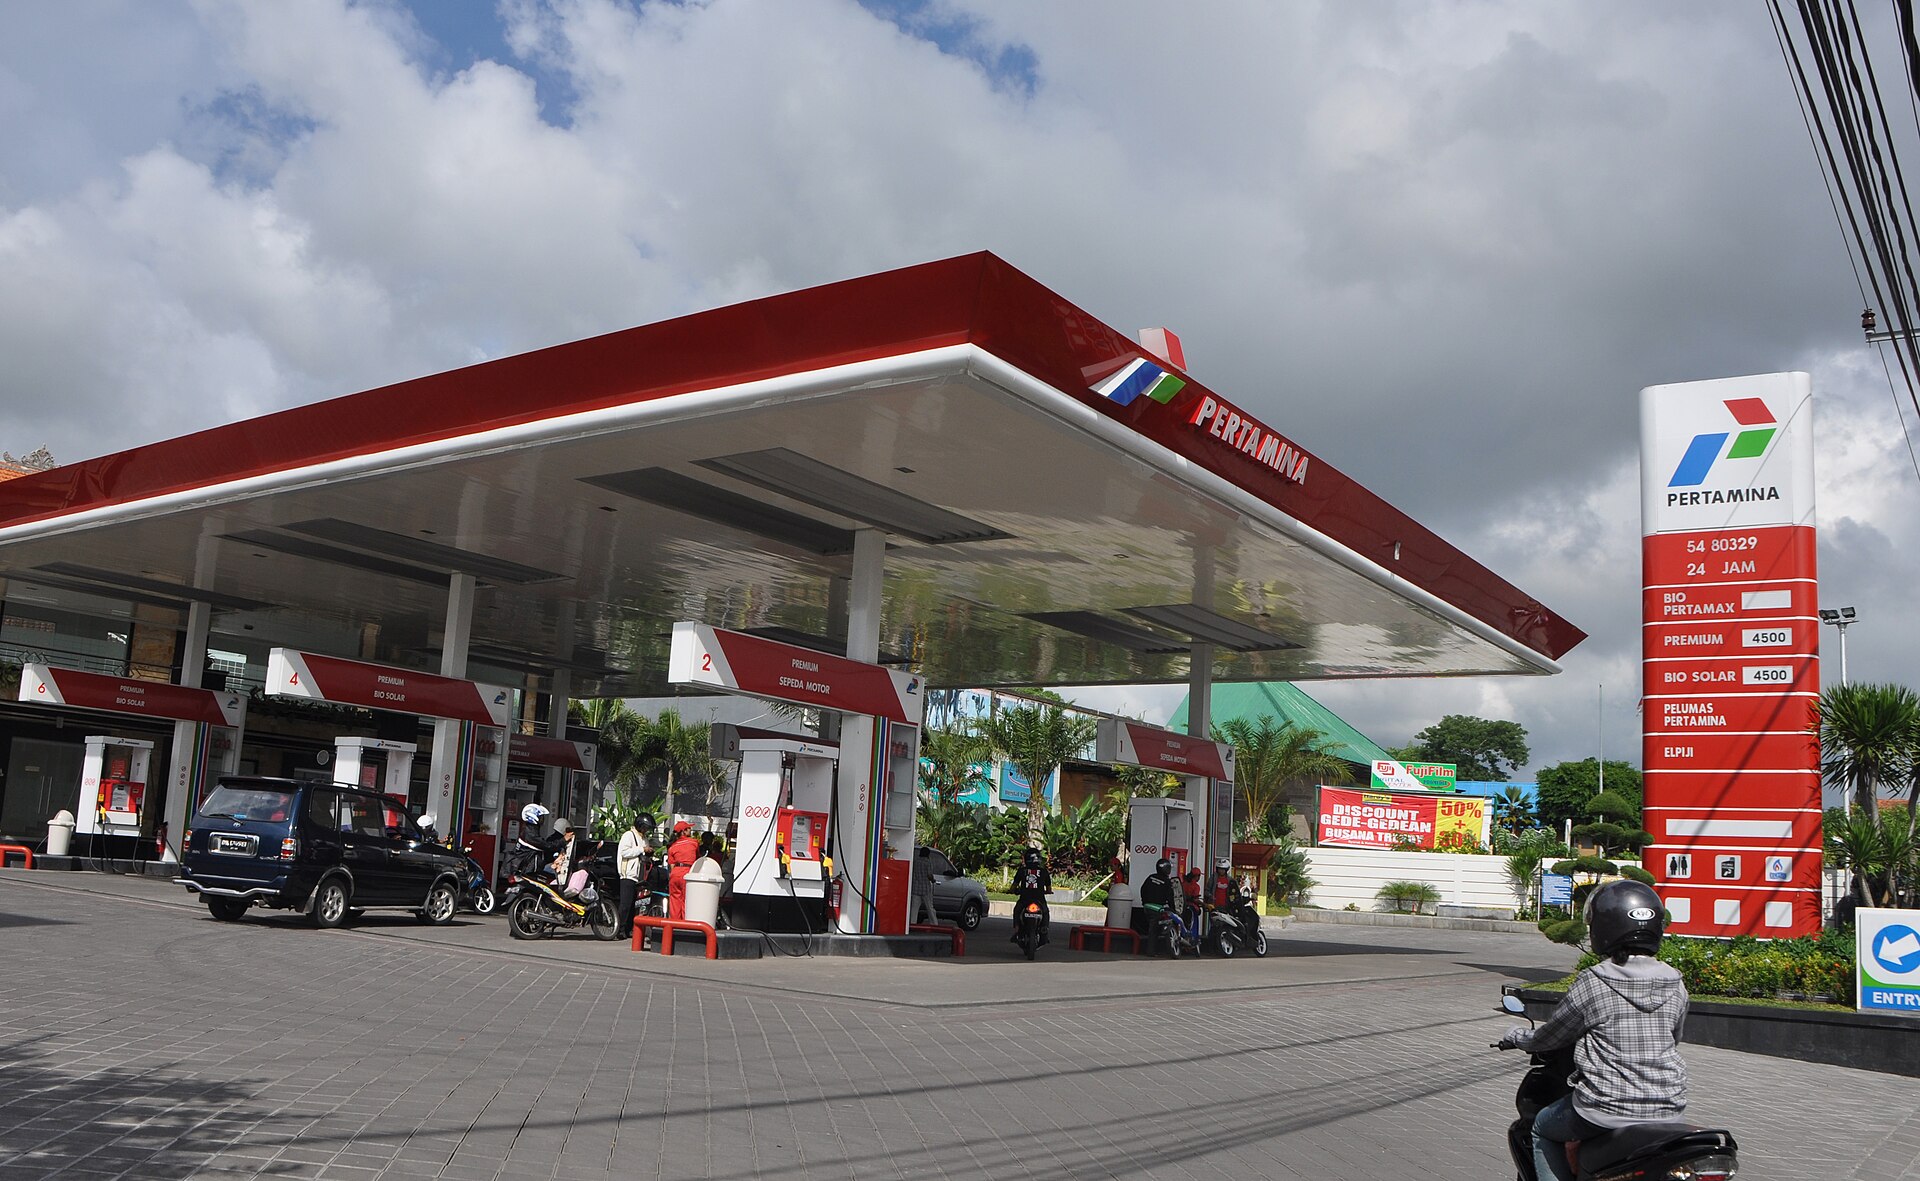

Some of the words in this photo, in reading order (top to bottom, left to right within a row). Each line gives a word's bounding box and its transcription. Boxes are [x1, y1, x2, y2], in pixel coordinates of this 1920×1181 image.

[1193, 395, 1309, 486] PERTAMINA
[1667, 486, 1780, 507] PERTAMINA
[1686, 539, 1705, 553] 54
[1710, 536, 1758, 552] 80329
[1686, 562, 1706, 576] 24
[1721, 560, 1756, 575] JAM
[1663, 592, 1687, 604] BIO
[1663, 602, 1735, 616] PERTAMAX
[1663, 633, 1724, 646] PREMIUM
[1752, 632, 1786, 643] 4500
[702, 653, 711, 672] 2
[791, 658, 819, 673] PREMIUM
[289, 671, 299, 687] 4
[377, 675, 405, 686] PREMIUM
[1664, 671, 1687, 683] BIO
[1692, 670, 1736, 682] SOLAR
[1753, 670, 1787, 681] 4500
[37, 682, 46, 694] 6
[120, 685, 145, 694] PREMIUM
[779, 676, 804, 690] SEPEDA
[805, 681, 830, 694] MOTOR
[116, 697, 126, 705] BIO
[127, 699, 145, 707] SOLAR
[373, 690, 385, 699] BIO
[385, 692, 406, 702] SOLAR
[1664, 702, 1714, 714] PELUMAS
[1664, 715, 1727, 727] PERTAMINA
[728, 740, 735, 752] 3
[1119, 740, 1124, 753] 1
[1664, 747, 1694, 758] ELPIJI
[1405, 764, 1455, 778] FujiFilm
[1333, 803, 1420, 821] DISCOUNT
[1441, 801, 1482, 818] 50%
[1320, 813, 1432, 834] GEDE-GEDEAN
[1325, 827, 1375, 841] BUSANA
[1872, 991, 1920, 1006] ENTRY
